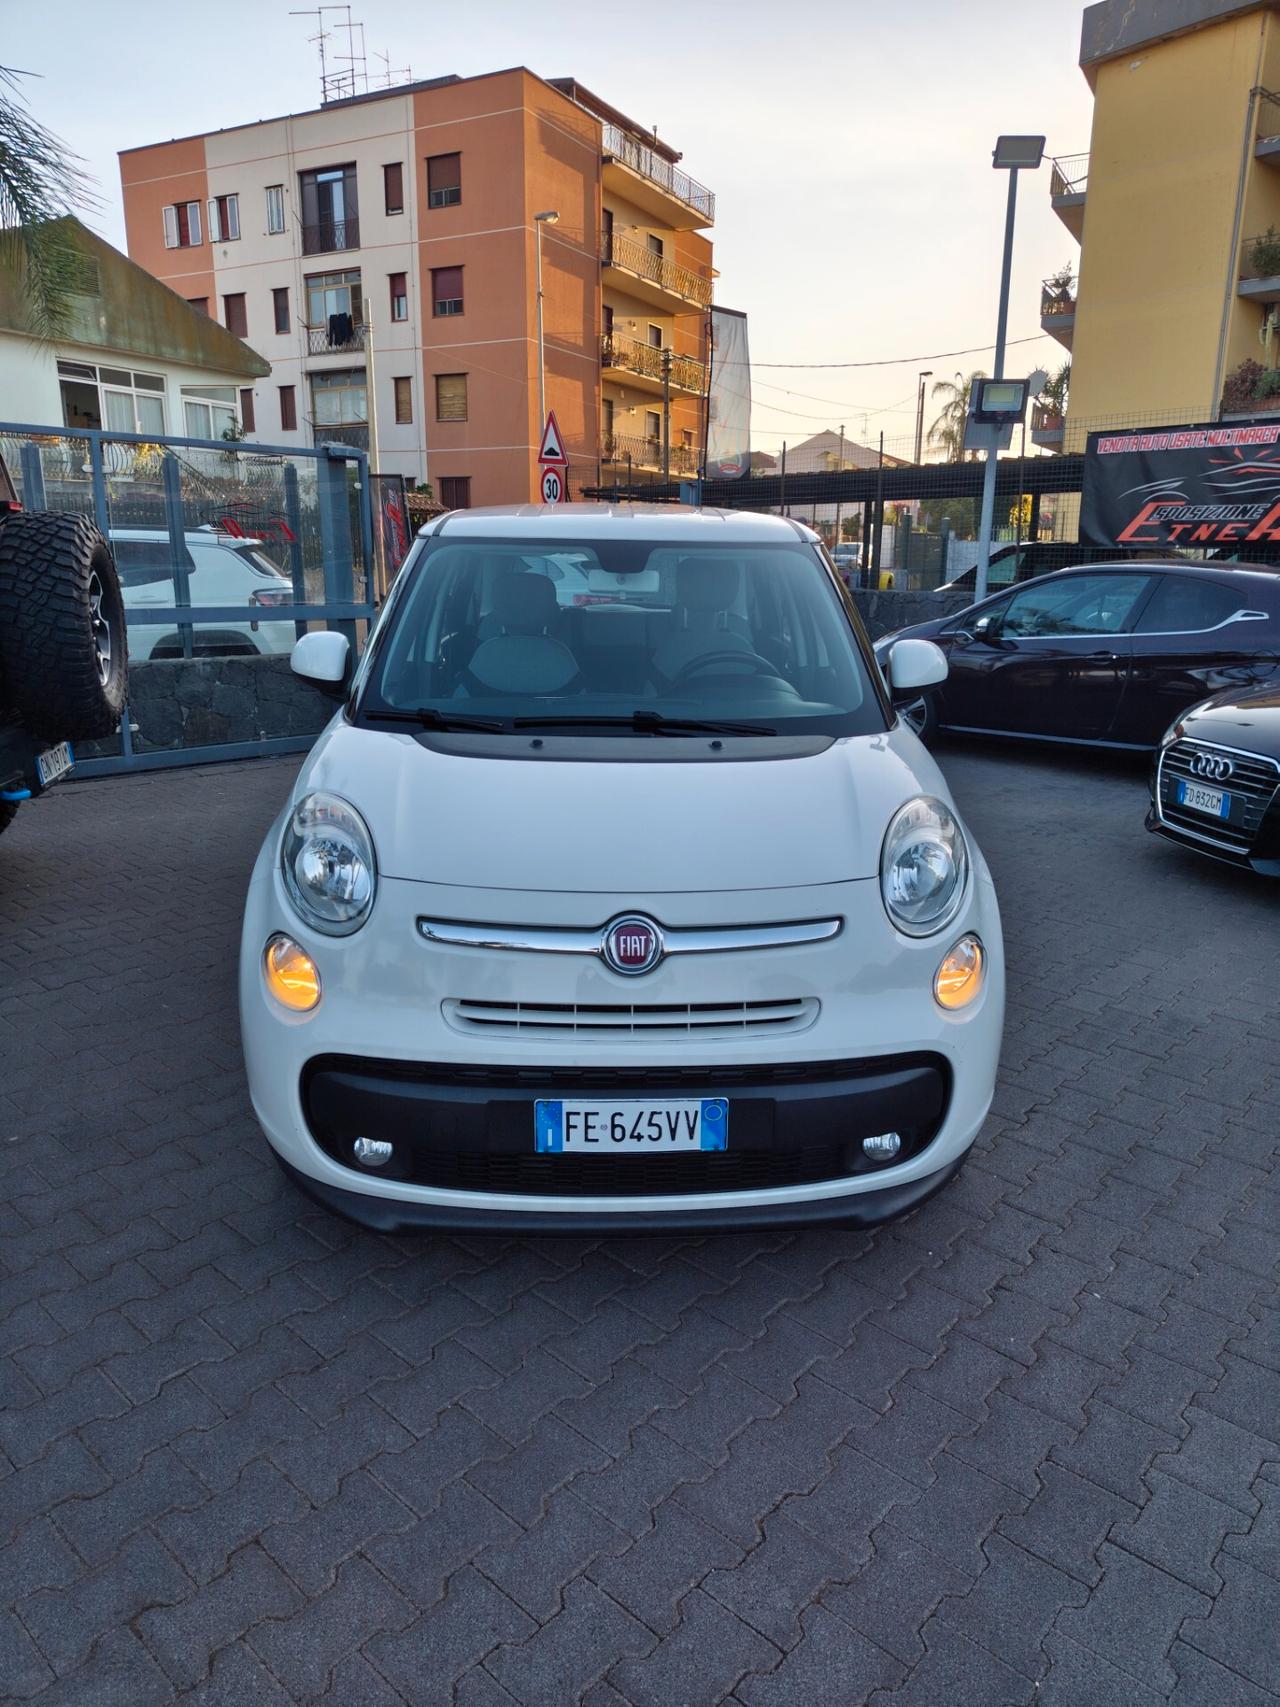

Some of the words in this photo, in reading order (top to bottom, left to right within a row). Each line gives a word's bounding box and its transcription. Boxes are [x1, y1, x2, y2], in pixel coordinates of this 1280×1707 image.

[1097, 437, 1140, 454] VENDITA
[1139, 434, 1168, 451] AUTO
[1168, 431, 1207, 449] USATE
[545, 479, 558, 499] 30
[619, 935, 647, 957] FIAT
[565, 1111, 600, 1143] FE
[610, 1110, 699, 1143] 645VV
